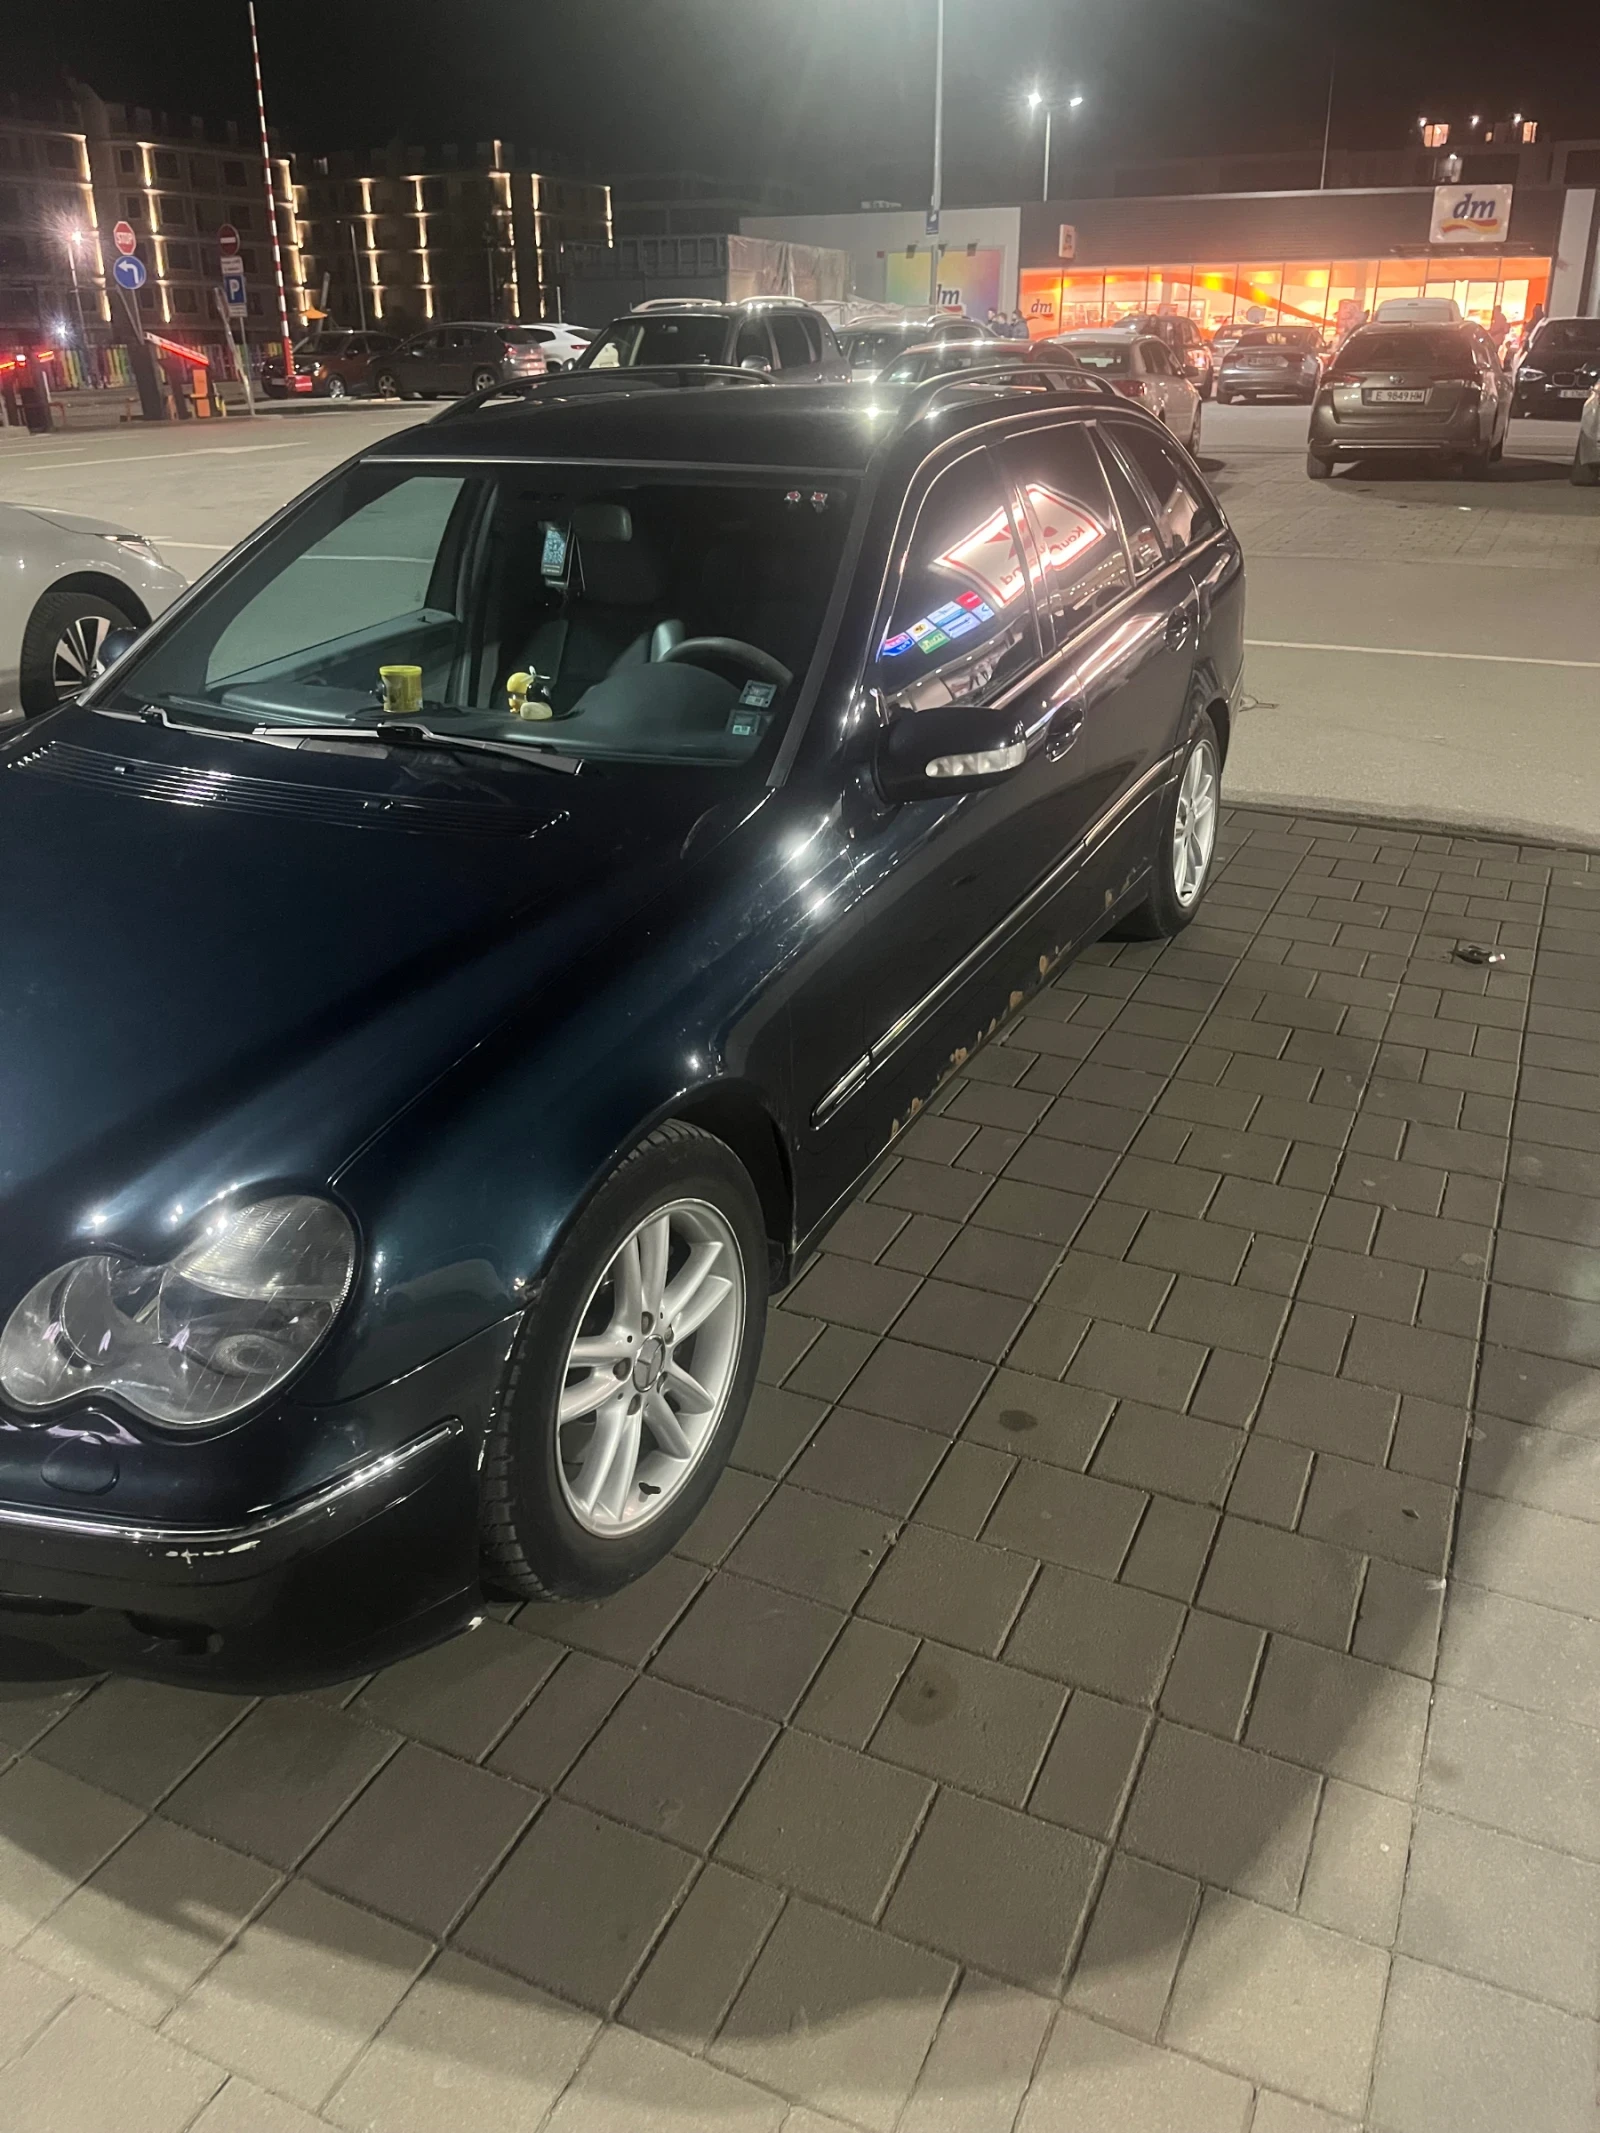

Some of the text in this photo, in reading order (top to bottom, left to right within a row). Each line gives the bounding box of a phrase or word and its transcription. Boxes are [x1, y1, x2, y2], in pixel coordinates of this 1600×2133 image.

[1453, 193, 1496, 219] dm
[116, 231, 133, 245] STOP
[229, 279, 240, 301] P
[1030, 298, 1052, 313] dm
